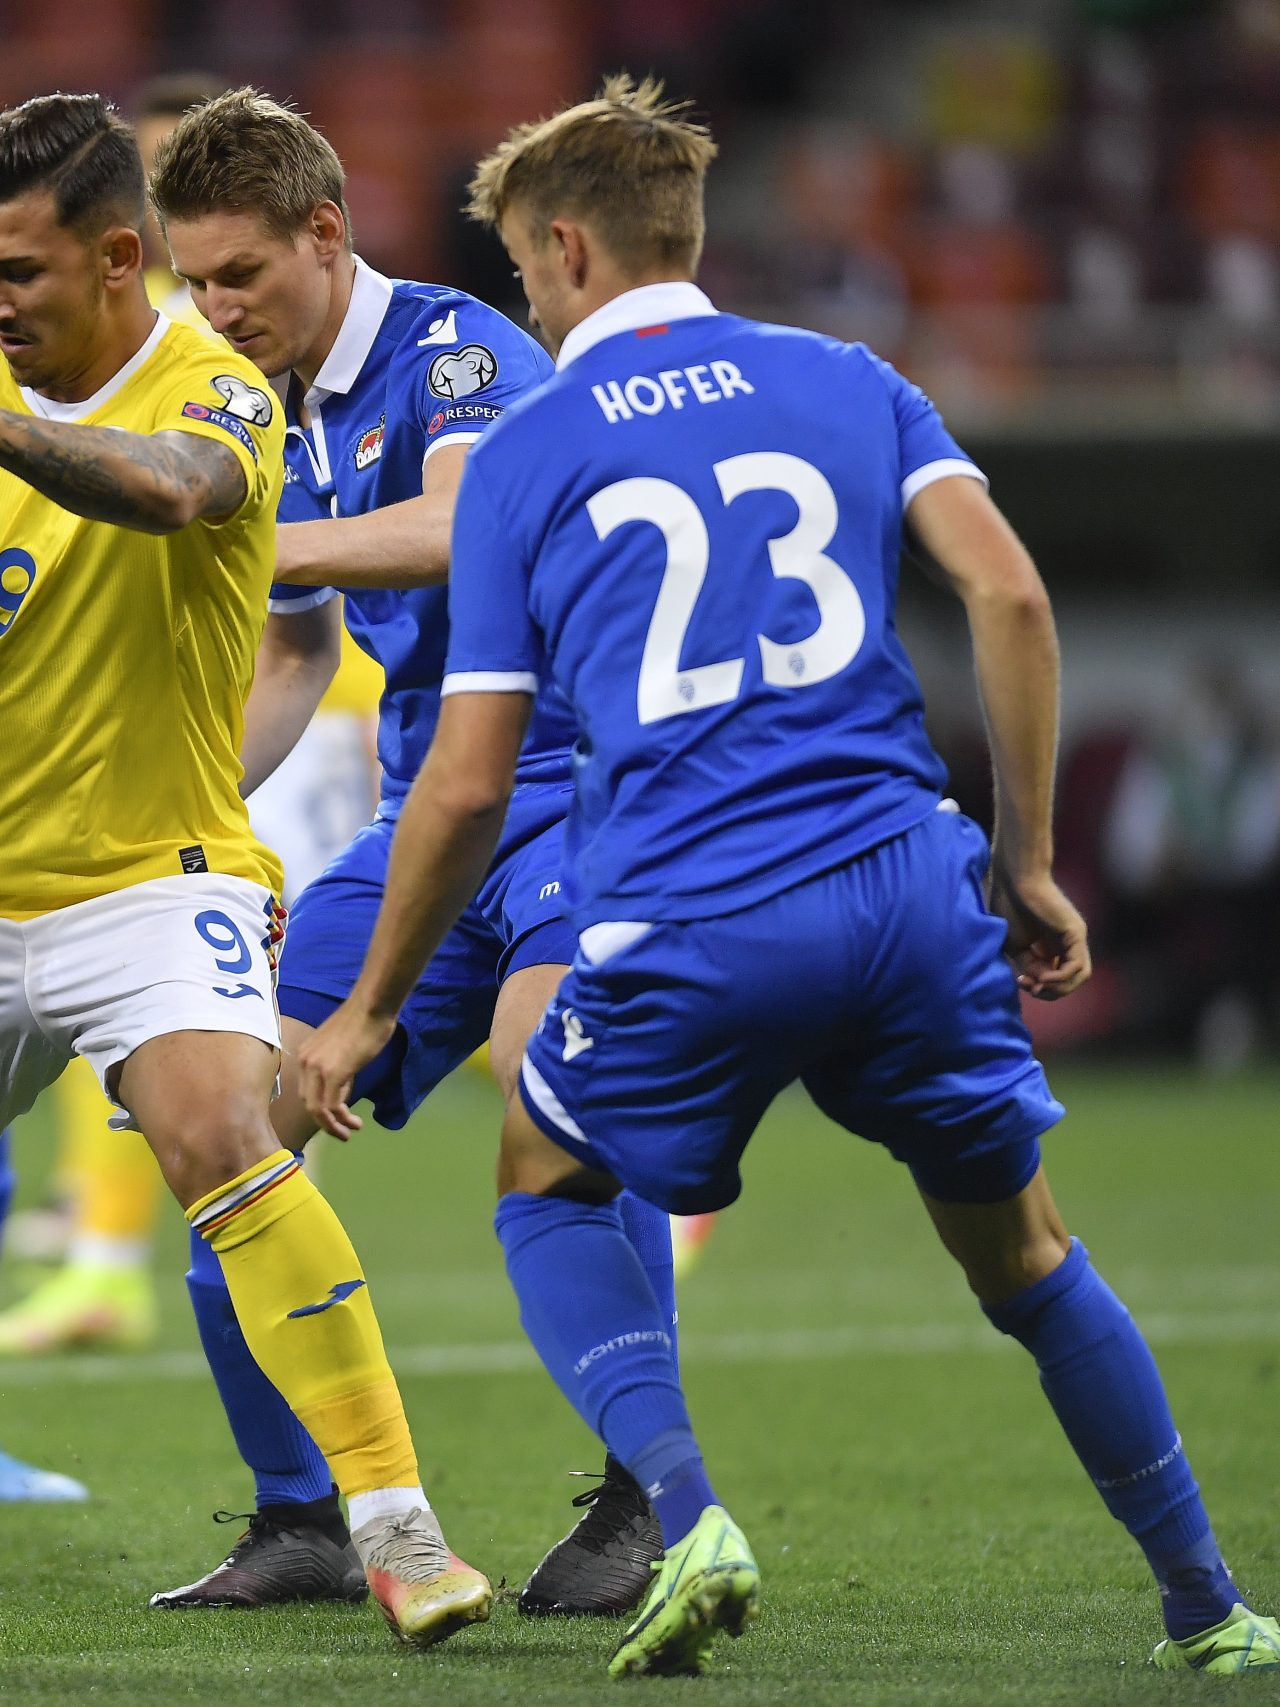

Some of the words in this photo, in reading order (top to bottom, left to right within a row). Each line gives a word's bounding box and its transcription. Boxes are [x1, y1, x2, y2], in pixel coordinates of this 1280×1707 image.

[446, 406, 505, 420] RESPEC
[591, 359, 756, 424] HOFER
[585, 451, 866, 726] 23
[194, 909, 252, 974] 9
